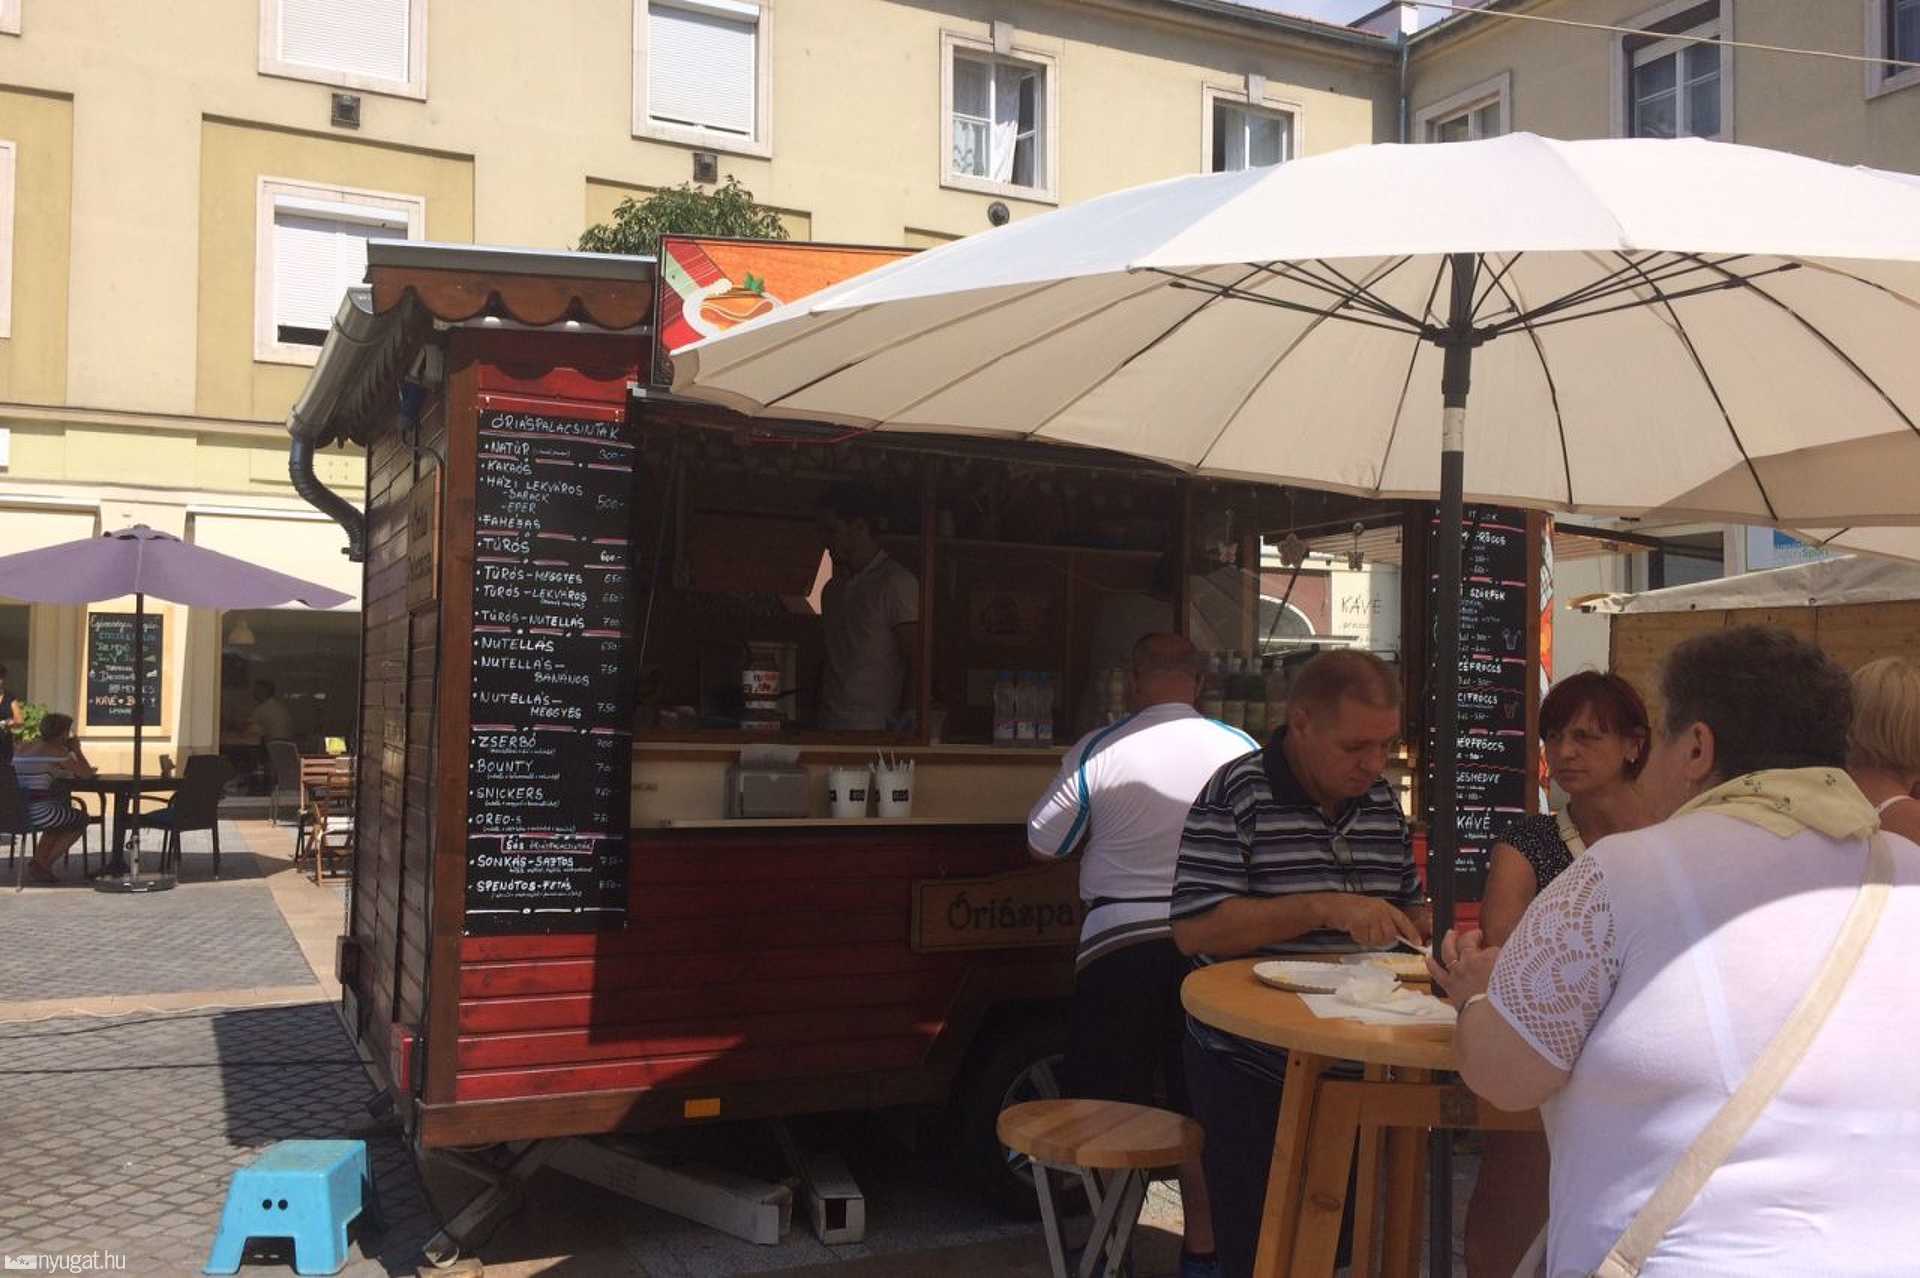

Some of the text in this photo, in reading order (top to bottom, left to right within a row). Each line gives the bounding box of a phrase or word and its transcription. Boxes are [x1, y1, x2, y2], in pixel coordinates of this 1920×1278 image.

[482, 635, 554, 652] NUTELLÁS
[477, 758, 535, 773] BOUNTY
[477, 788, 544, 800] SNICKERS
